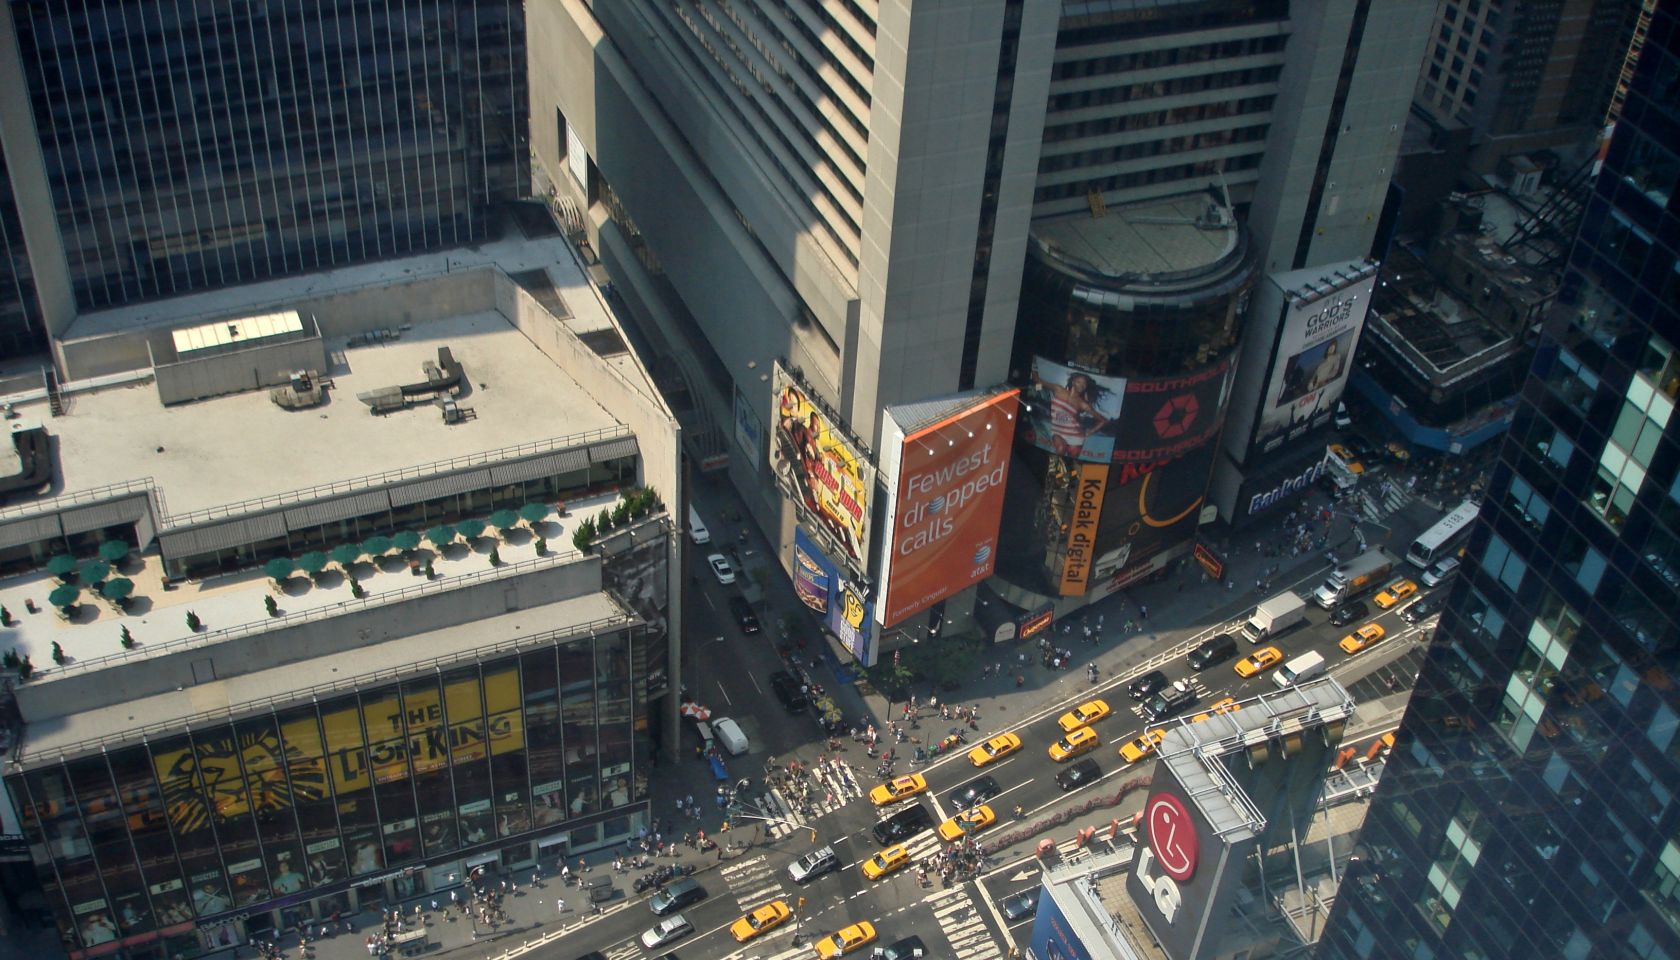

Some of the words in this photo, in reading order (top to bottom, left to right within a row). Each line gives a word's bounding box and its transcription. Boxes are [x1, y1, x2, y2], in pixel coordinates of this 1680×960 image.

[1305, 312, 1350, 338] WARRIORS
[1307, 298, 1353, 328] GOD'S
[814, 461, 840, 495] RUSH
[840, 488, 863, 523] HOUR
[907, 444, 991, 500] Fewest
[1248, 479, 1293, 514] Bank
[1076, 479, 1101, 529] Kodak
[901, 518, 953, 555] calls
[1065, 533, 1090, 583] digital
[387, 704, 441, 733] THE
[338, 740, 421, 782] LION
[426, 716, 511, 760] KING
[1137, 847, 1182, 924] LG
